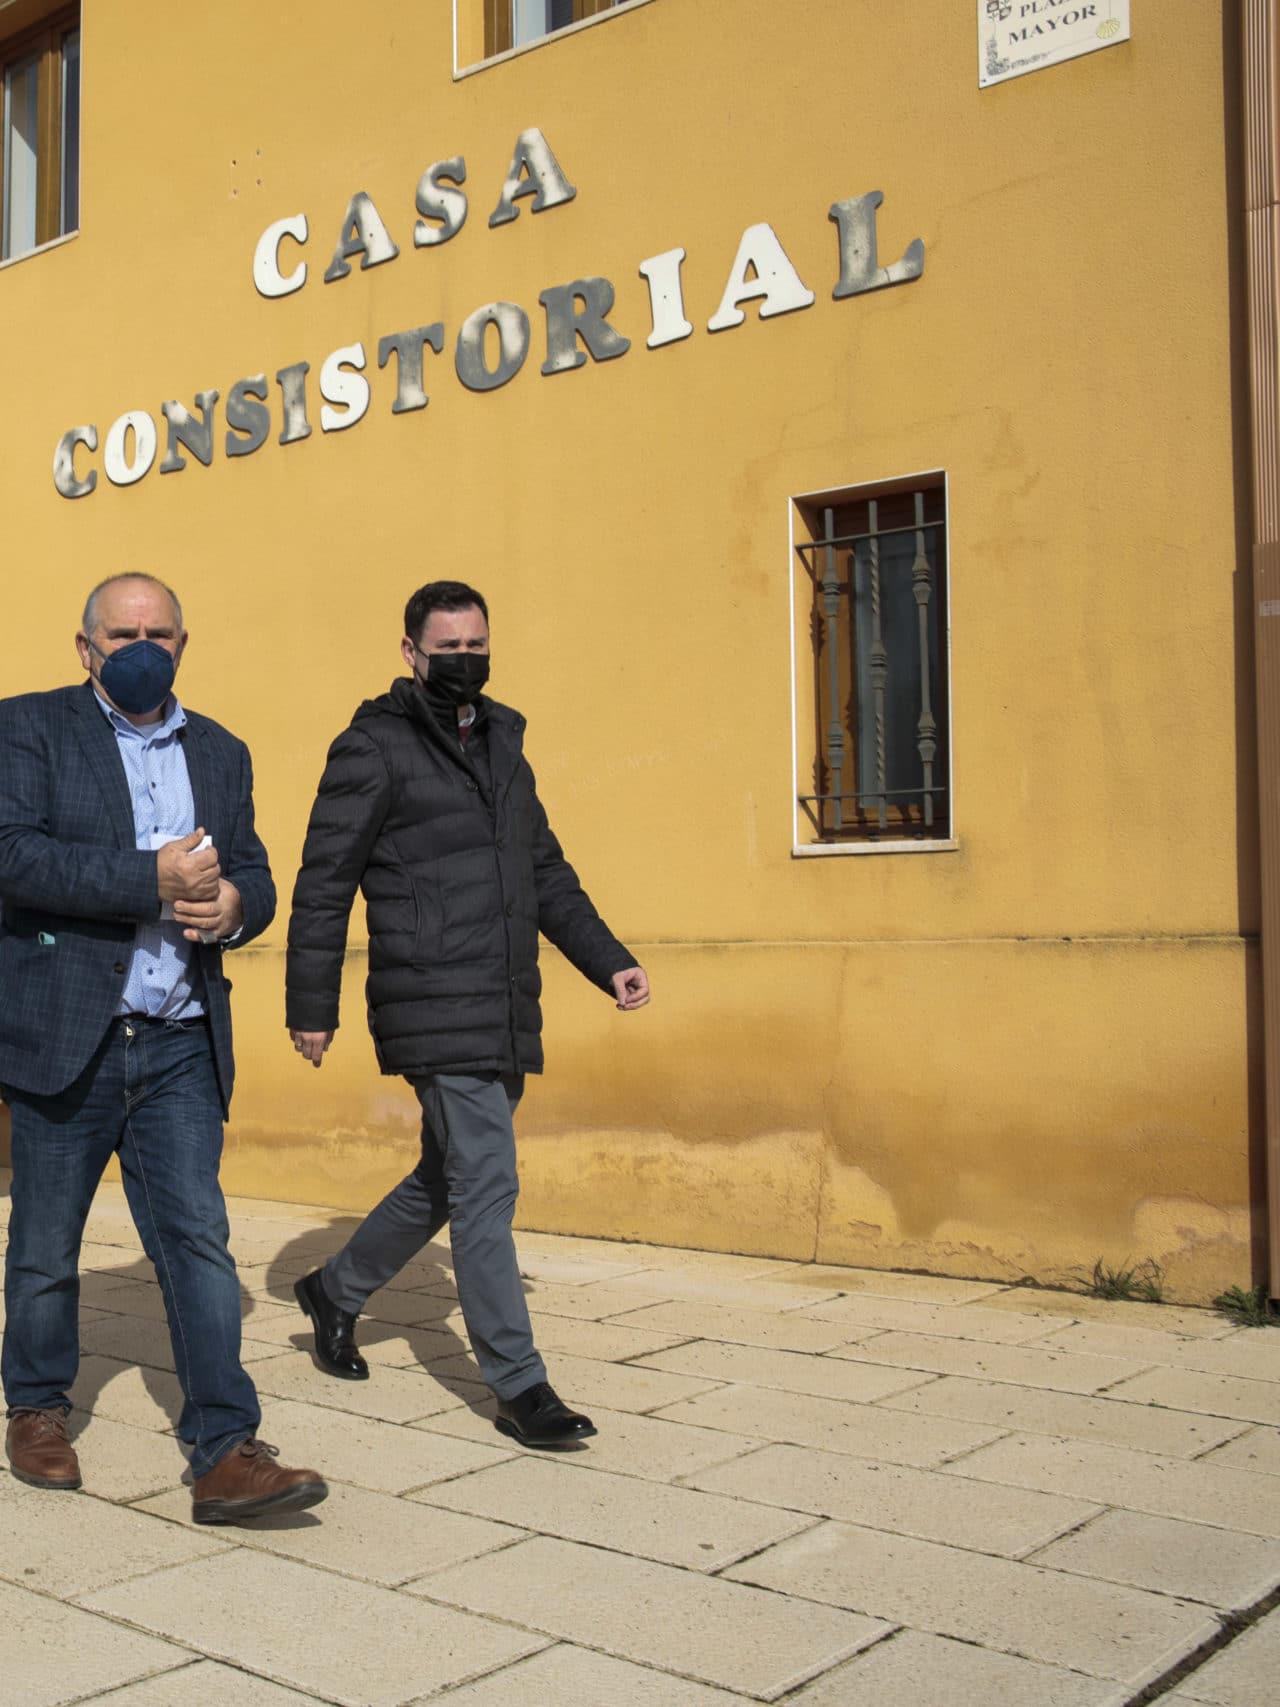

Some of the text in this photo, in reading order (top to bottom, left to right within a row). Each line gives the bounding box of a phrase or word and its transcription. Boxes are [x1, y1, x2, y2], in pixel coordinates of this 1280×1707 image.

[1009, 4, 1097, 45] MAYOR
[1020, 0, 1070, 17] PLA
[252, 127, 578, 299] CASA
[53, 189, 926, 500] CONSISTORIAL
